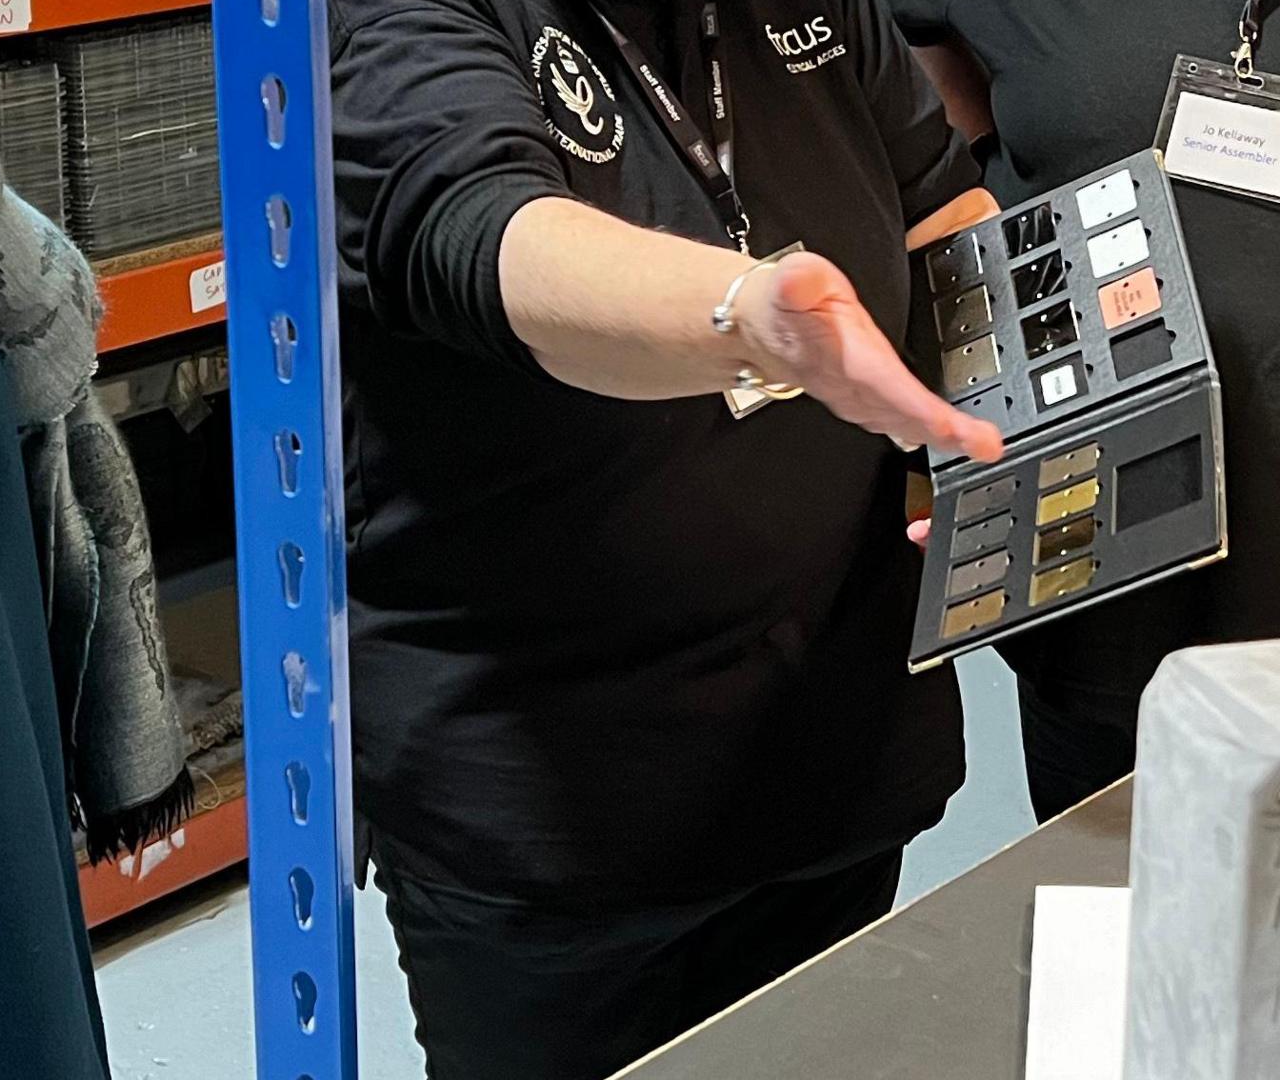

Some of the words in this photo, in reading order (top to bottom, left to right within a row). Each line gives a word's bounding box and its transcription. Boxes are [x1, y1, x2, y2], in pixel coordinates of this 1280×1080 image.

[639, 64, 659, 87] Staff
[654, 84, 681, 121] Member
[1183, 136, 1217, 152] Senior
